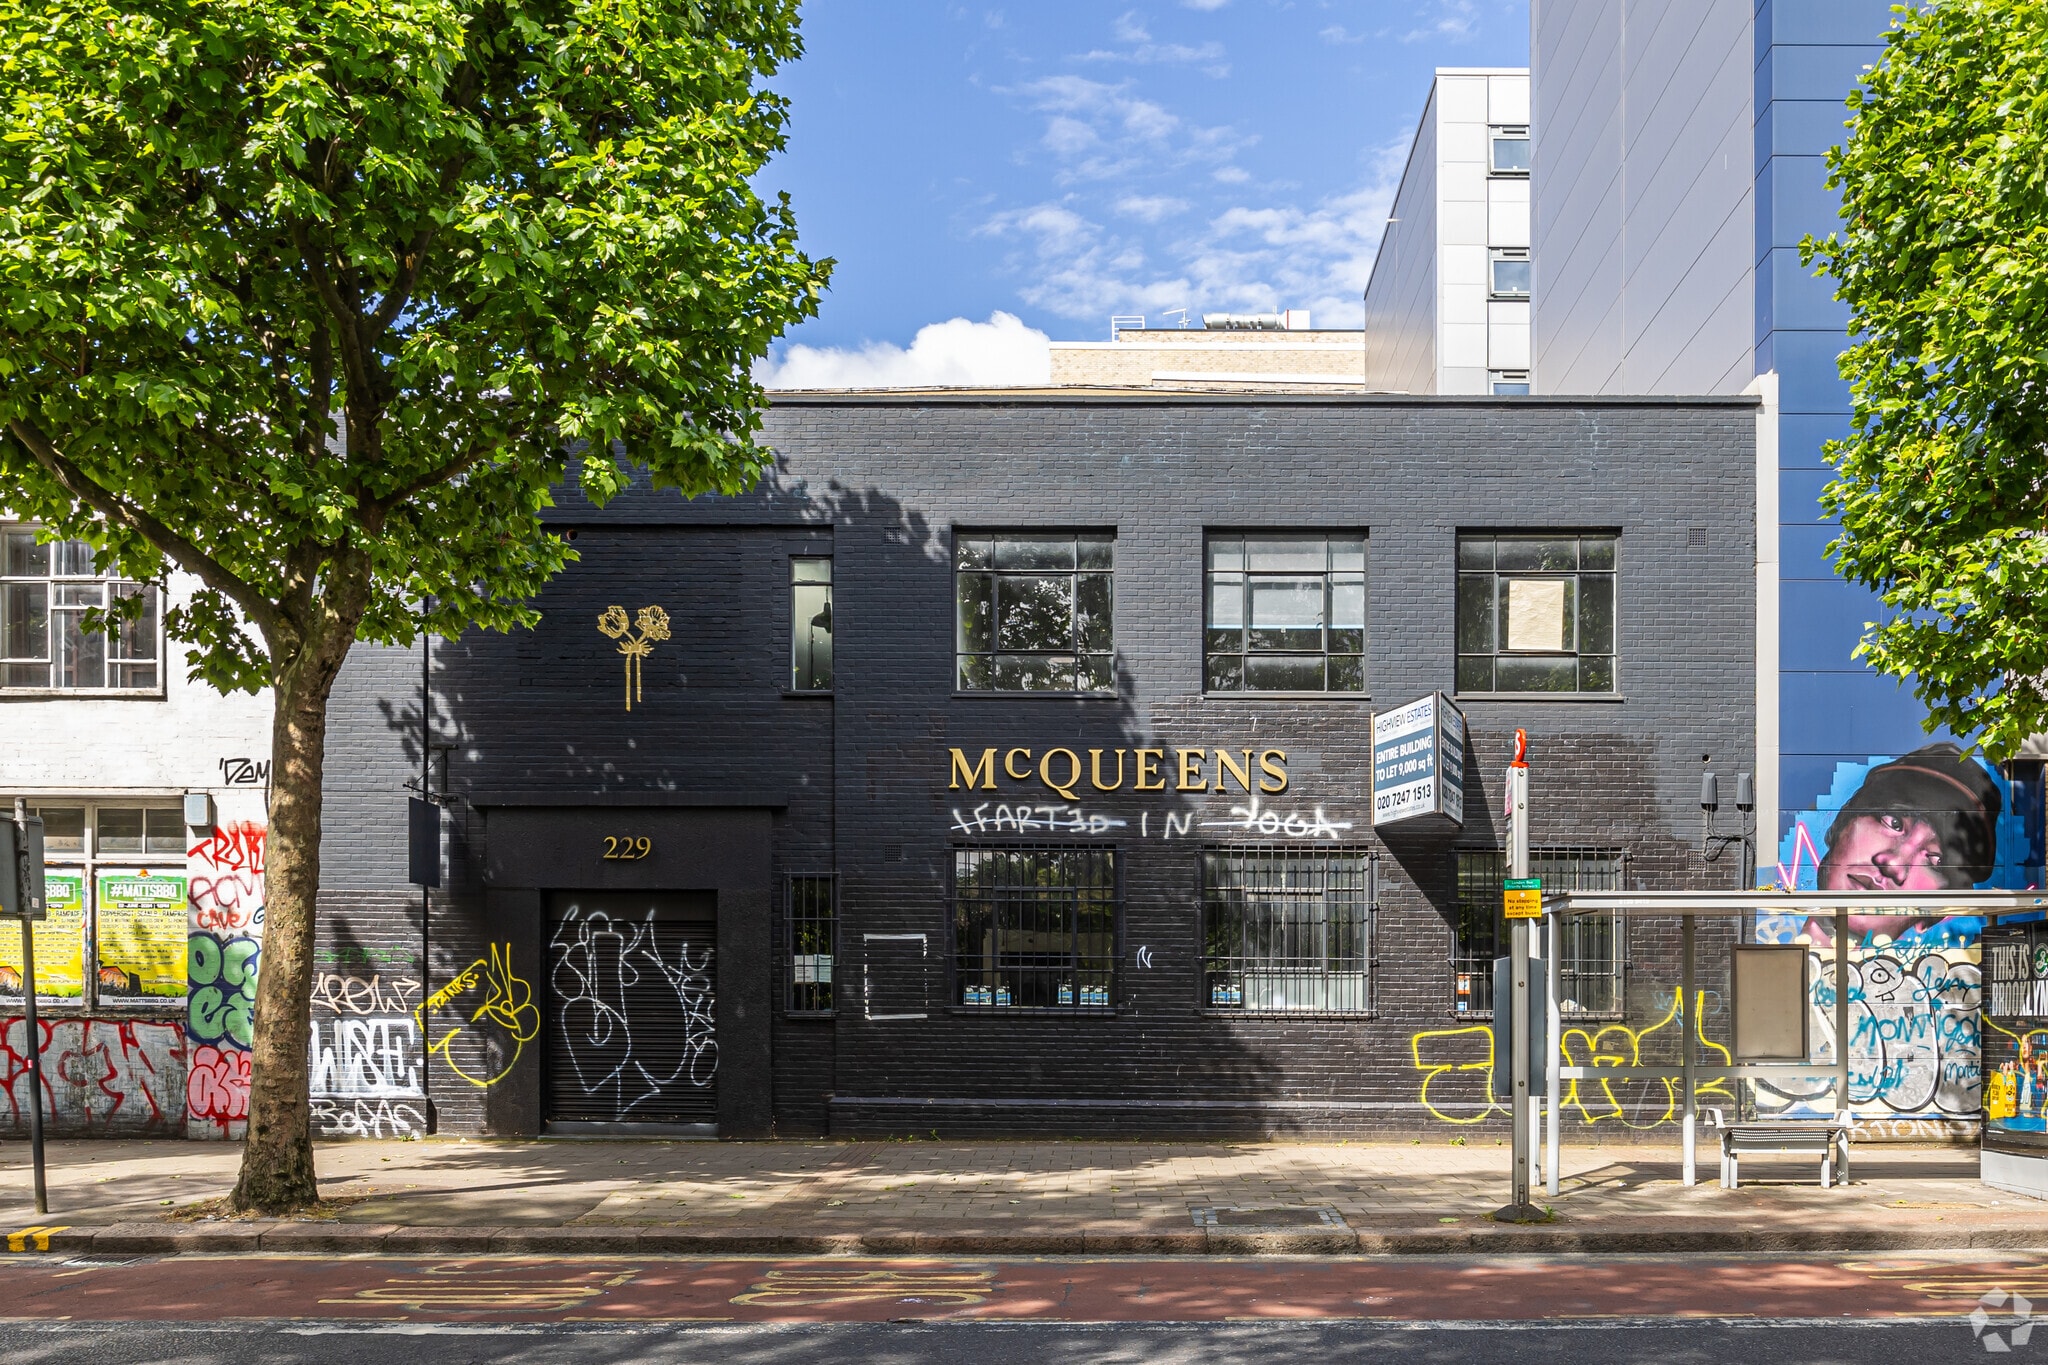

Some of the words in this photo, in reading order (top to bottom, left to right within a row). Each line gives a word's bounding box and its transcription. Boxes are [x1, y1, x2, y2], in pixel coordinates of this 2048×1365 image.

[1407, 703, 1432, 723] ESTATES
[1376, 746, 1399, 764] ENTIRE
[1400, 735, 1432, 758] BUILDING
[1376, 768, 1385, 782] TO
[1386, 764, 1398, 779] LET
[1398, 759, 1417, 777] 9,000
[1418, 760, 1427, 772] sq
[1427, 753, 1433, 767] ft
[1377, 794, 1390, 810] 020
[1392, 790, 1410, 807] 7247
[1413, 784, 1431, 801] 1513
[1142, 811, 1193, 840] IN
[1229, 796, 1338, 840] YOGA
[603, 836, 651, 859] 229
[110, 884, 177, 898] #MATTSBBQ
[1992, 945, 2017, 981] THIS
[2018, 944, 2030, 980] IS
